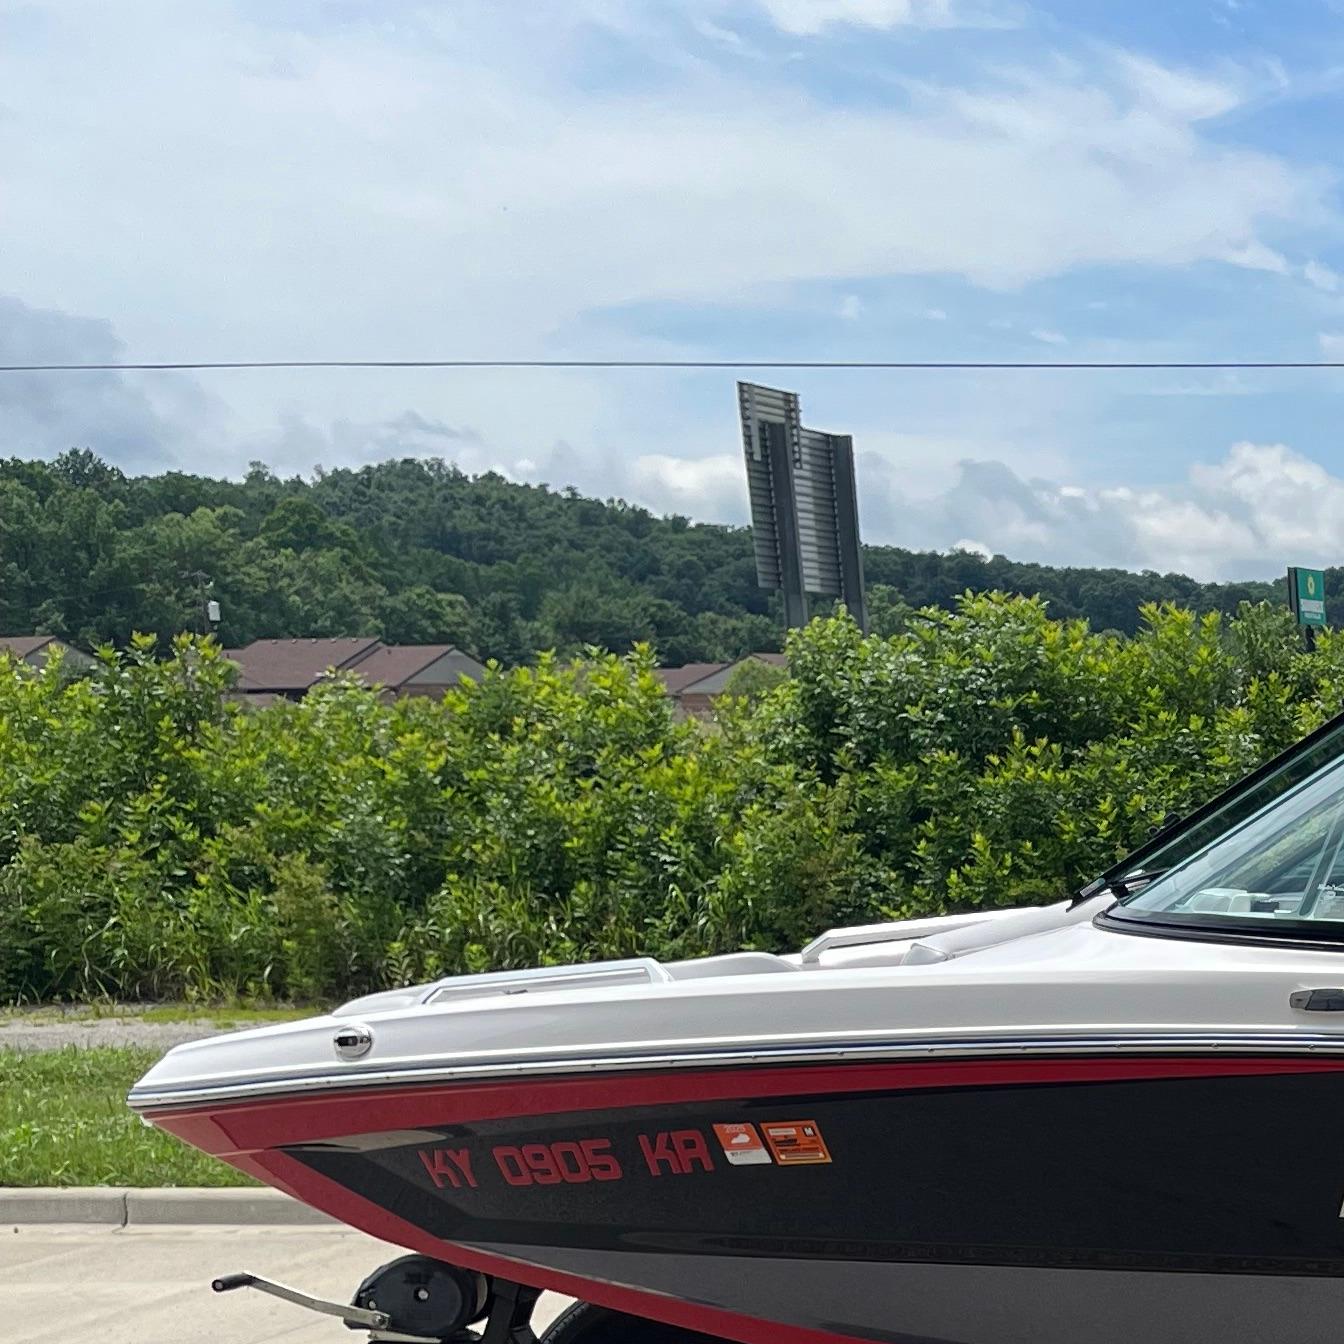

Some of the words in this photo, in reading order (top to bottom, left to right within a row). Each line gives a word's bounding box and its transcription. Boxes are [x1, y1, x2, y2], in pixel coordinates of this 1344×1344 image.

[418, 1149, 478, 1189] KY
[492, 1139, 623, 1186] 0905
[637, 1129, 715, 1176] KA
